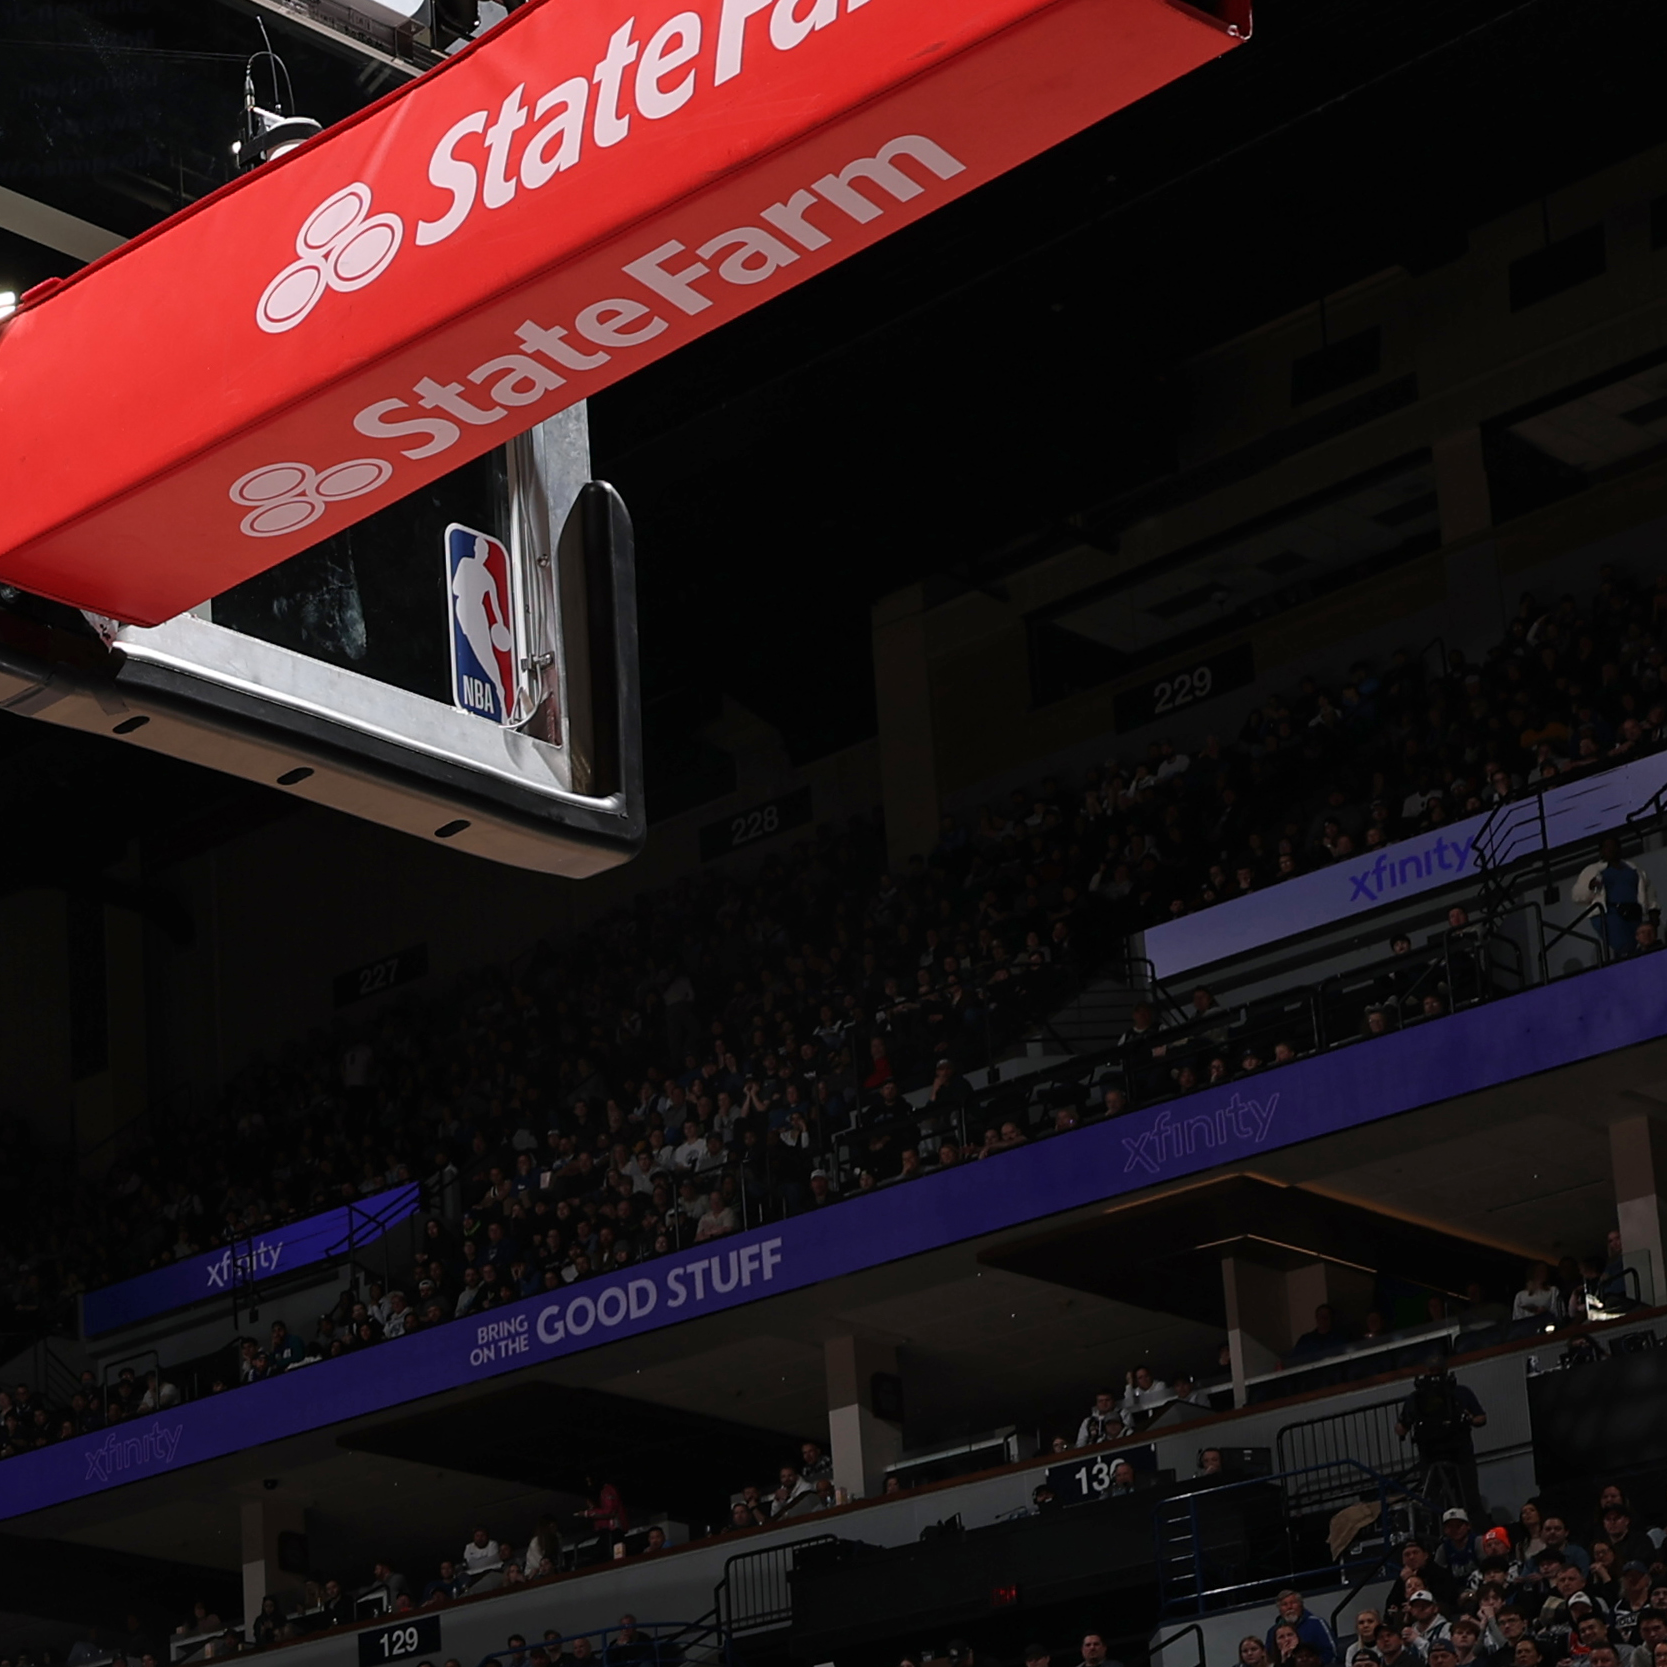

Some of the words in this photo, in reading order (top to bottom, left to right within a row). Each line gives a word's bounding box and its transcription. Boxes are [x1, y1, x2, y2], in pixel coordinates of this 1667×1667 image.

[415, 0, 866, 248] StateFa
[461, 676, 496, 715] NBA
[1152, 666, 1213, 714] 229
[730, 805, 780, 848] 228
[1348, 831, 1474, 904] xfinity
[357, 958, 400, 995] 227
[1122, 1089, 1282, 1175] xfinity
[476, 1314, 529, 1345] BRING
[535, 1276, 660, 1347] GOOD
[666, 1236, 784, 1311] STUFF
[469, 1344, 495, 1368] ON
[498, 1335, 531, 1361] THE
[378, 1625, 420, 1659] 129
